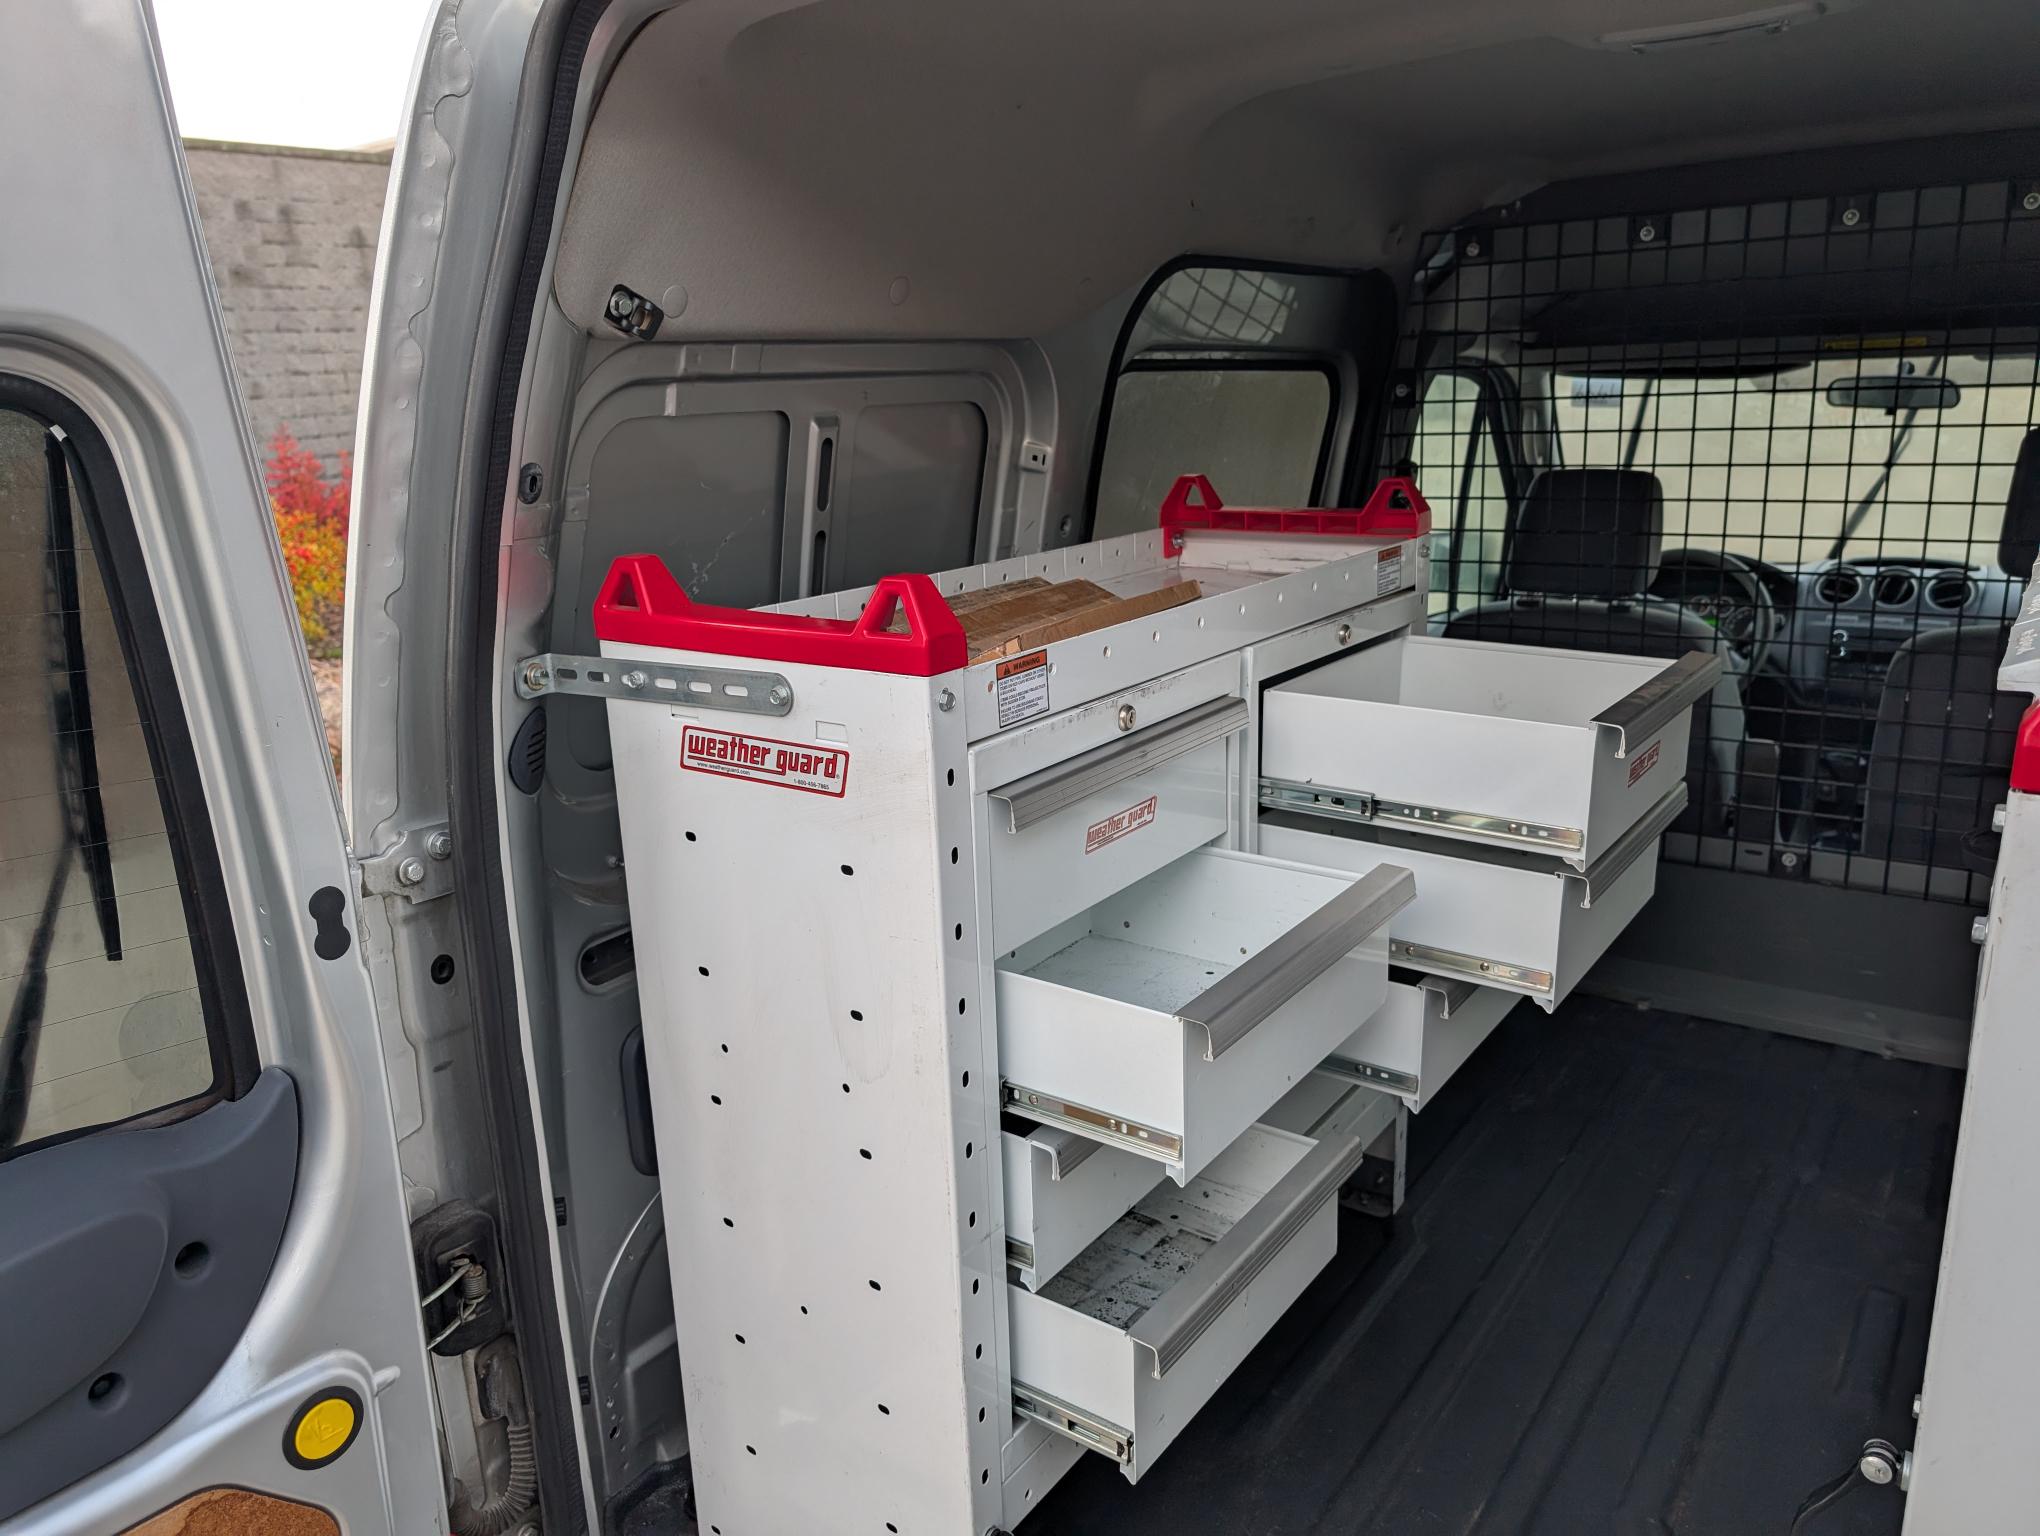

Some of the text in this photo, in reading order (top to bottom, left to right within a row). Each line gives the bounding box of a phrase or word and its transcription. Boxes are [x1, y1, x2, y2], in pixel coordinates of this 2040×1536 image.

[688, 735, 838, 779] weather guard
[1088, 799, 1154, 843] weather guard
